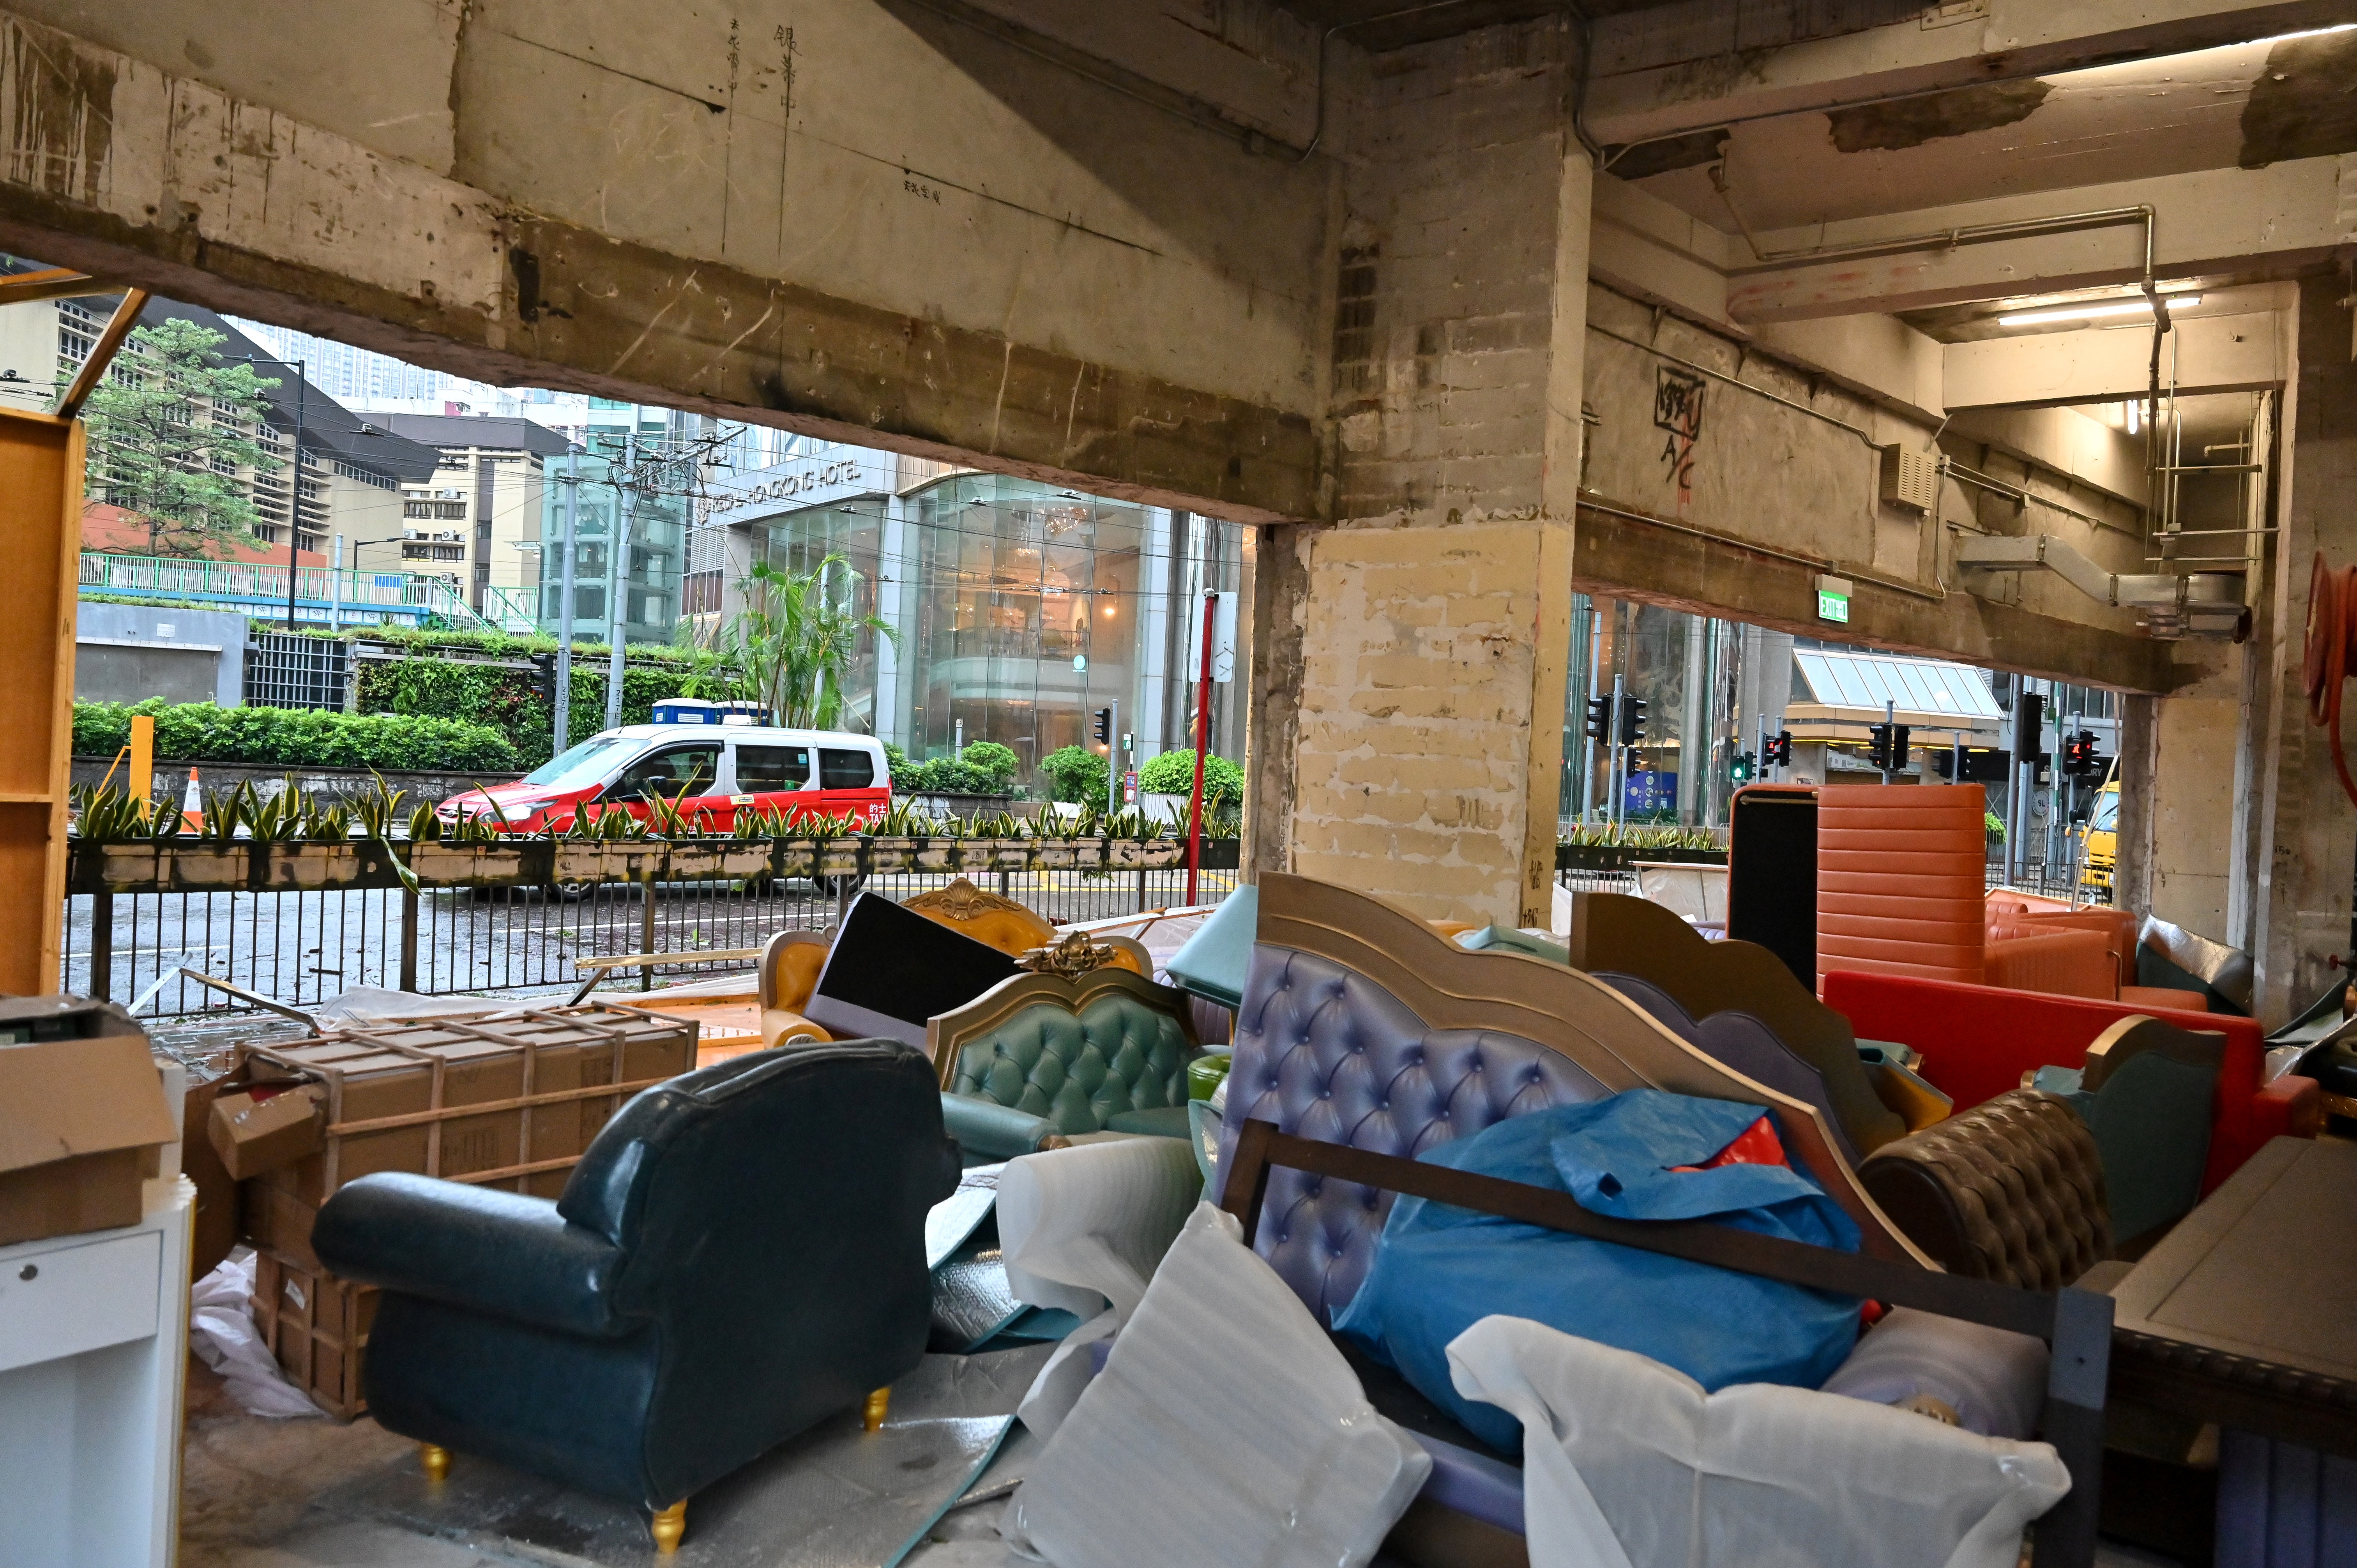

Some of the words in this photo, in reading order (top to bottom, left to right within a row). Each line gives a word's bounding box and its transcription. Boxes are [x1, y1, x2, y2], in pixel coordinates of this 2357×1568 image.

[818, 459, 861, 487] HOTEL
[1660, 434, 1695, 489] A/C
[1820, 596, 1836, 618] EXIT
[1835, 600, 1848, 620] 出口
[869, 803, 887, 813] 的士
[869, 813, 887, 824] TA
